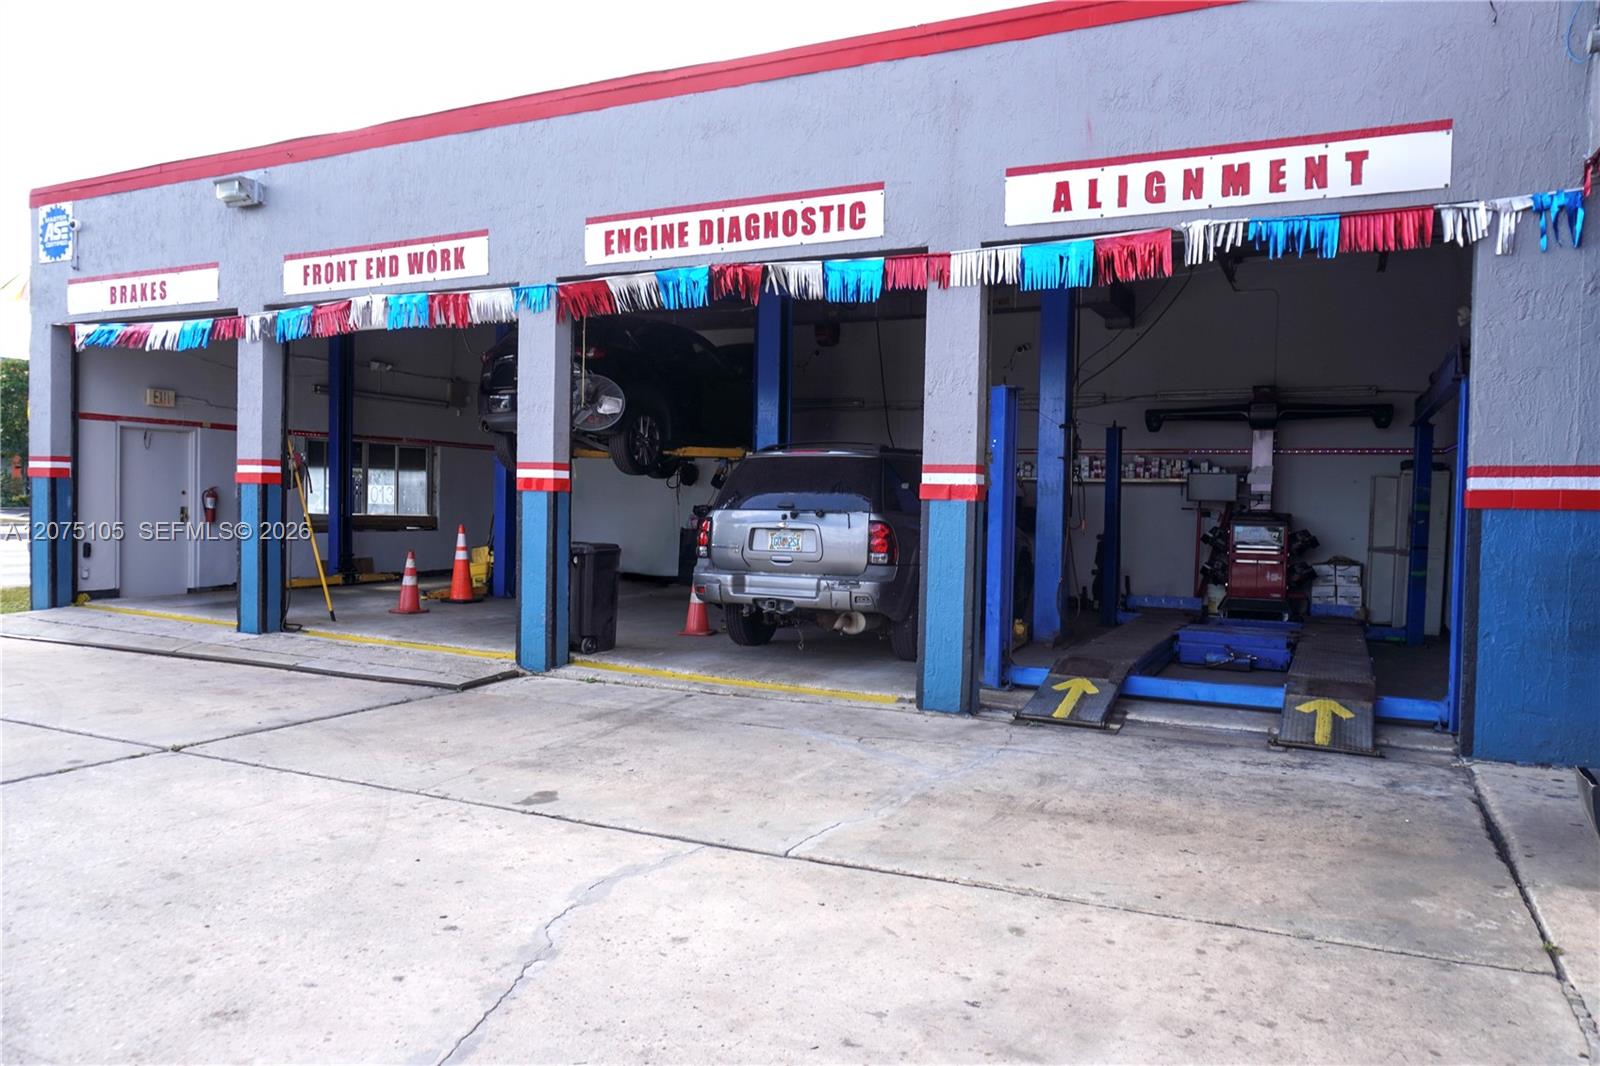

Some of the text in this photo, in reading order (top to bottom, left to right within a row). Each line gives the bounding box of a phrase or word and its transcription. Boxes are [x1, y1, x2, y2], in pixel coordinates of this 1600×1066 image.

[1052, 150, 1369, 213] ALIGNMENT
[43, 221, 70, 242] ASE
[604, 201, 866, 256] ENGINE DIAGNOSTIC
[303, 246, 466, 286] FRONT END WORK
[110, 280, 167, 305] BRAKES
